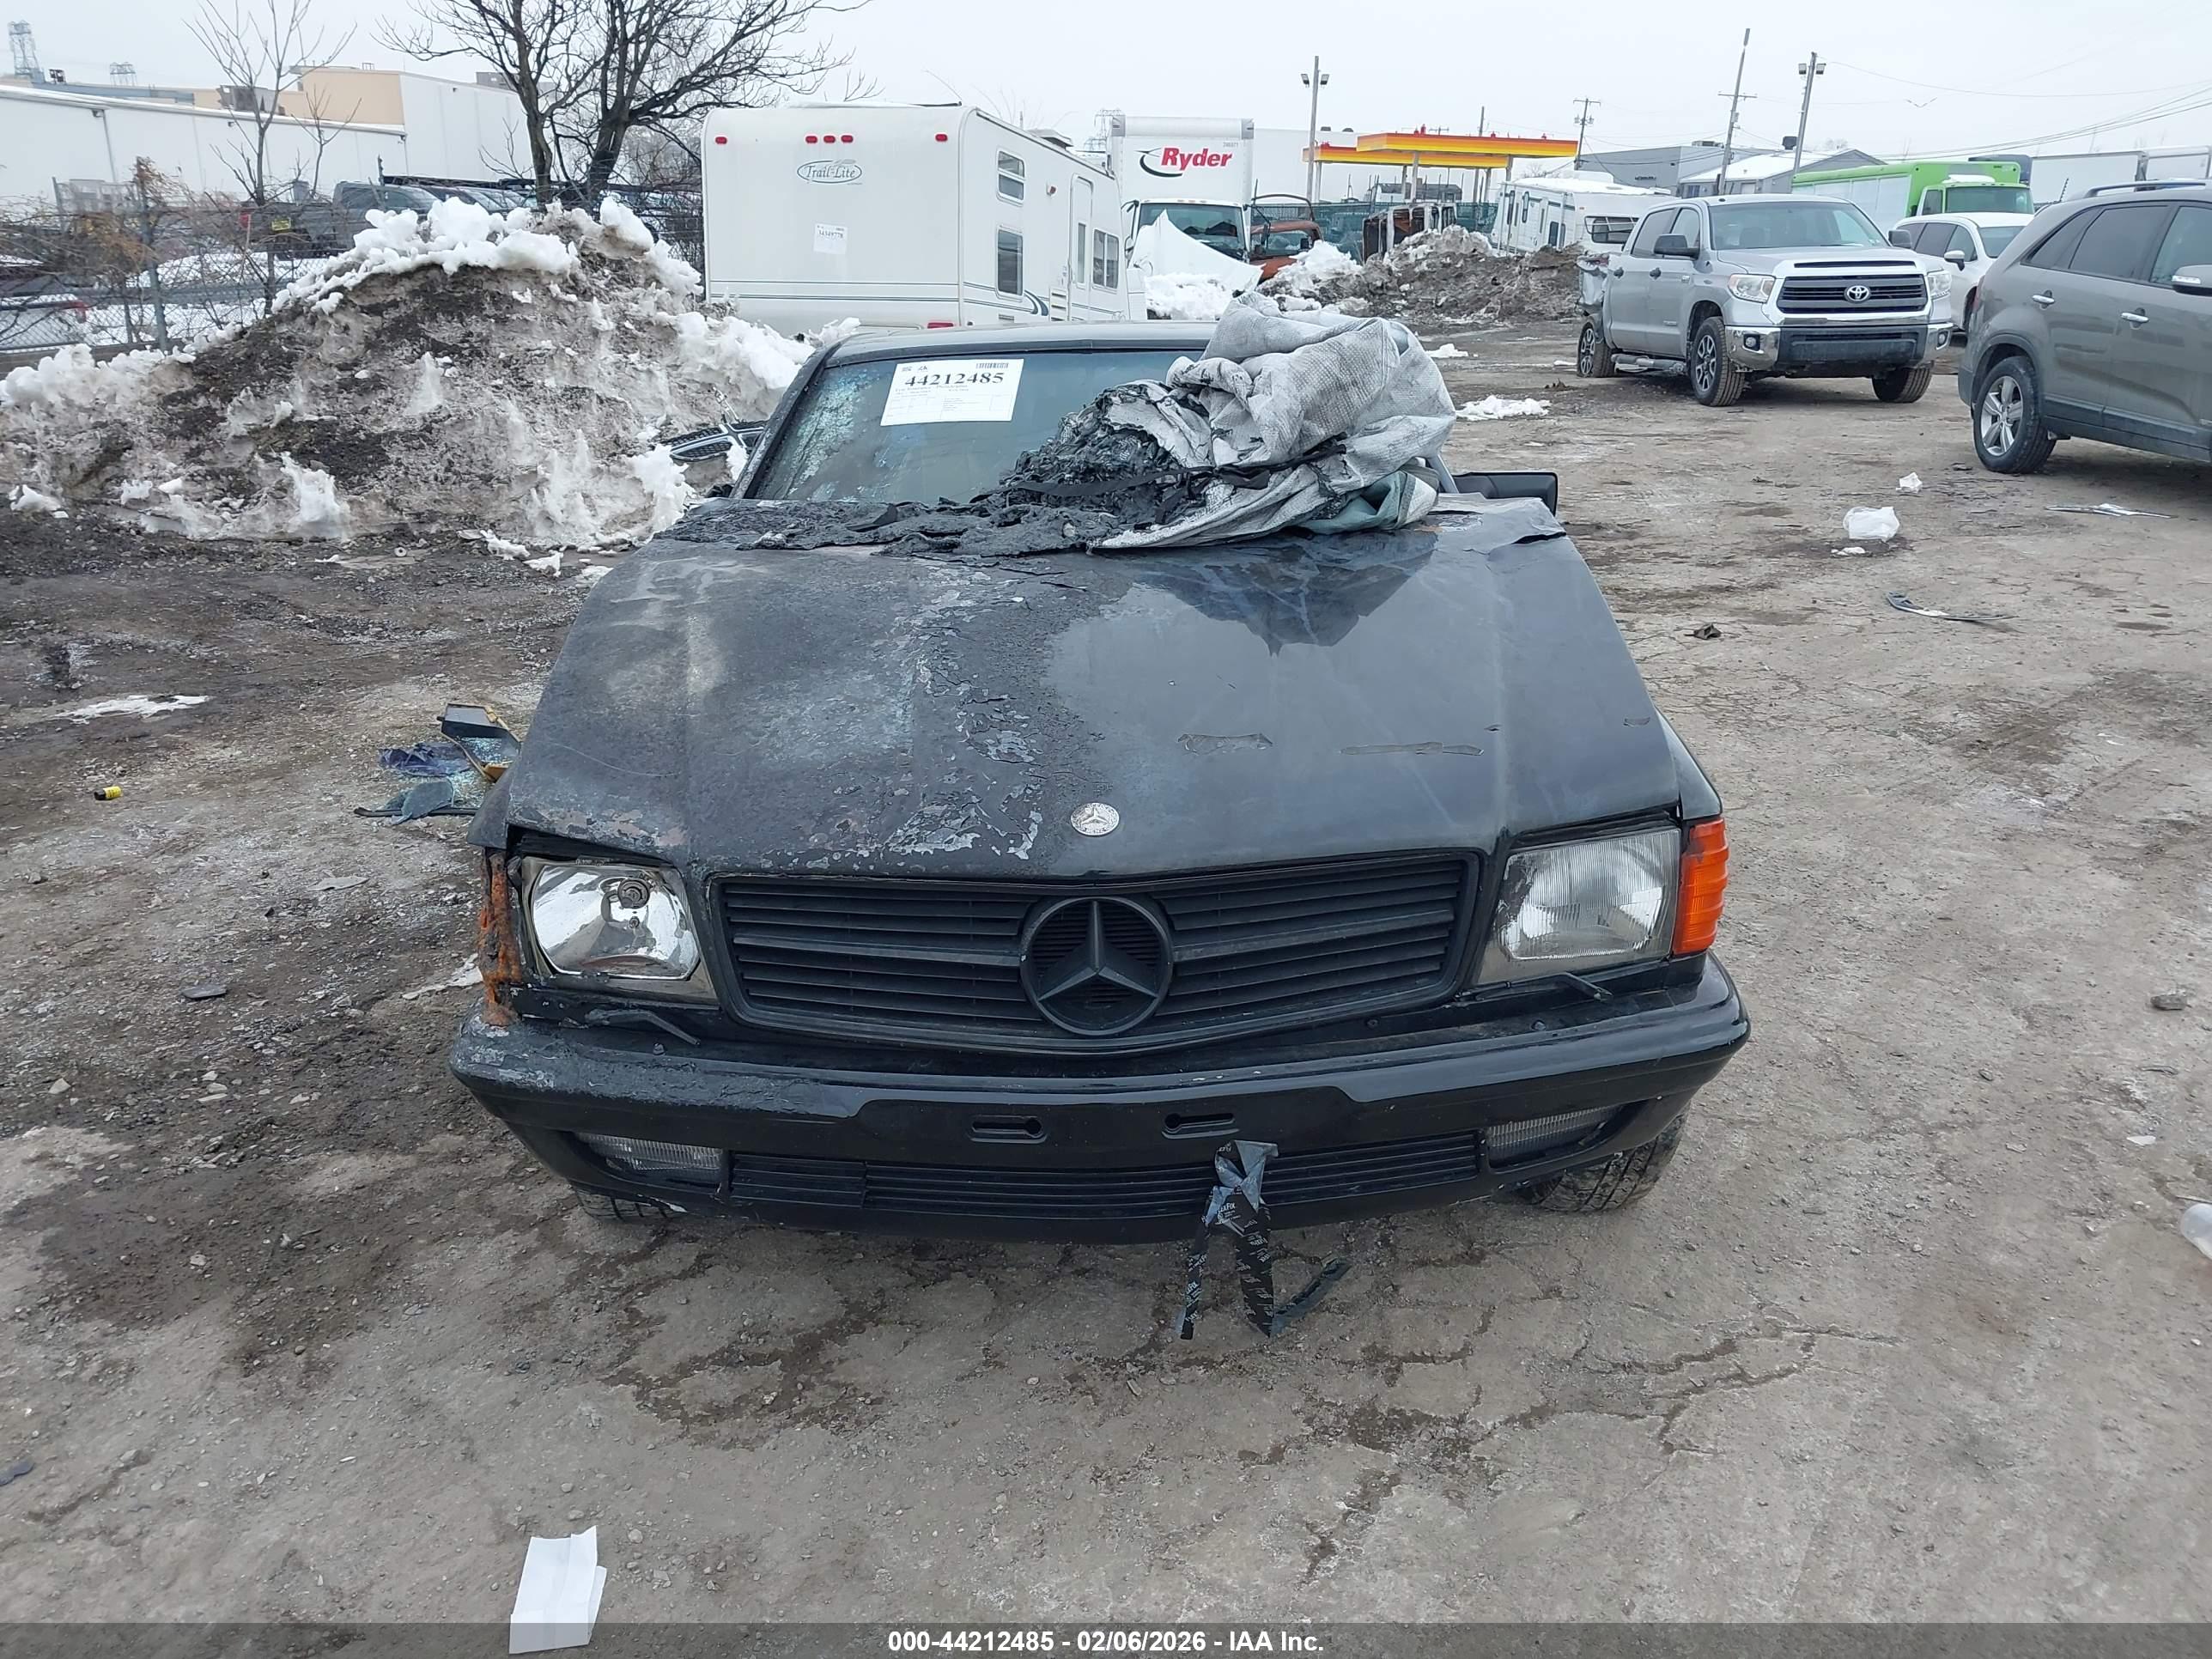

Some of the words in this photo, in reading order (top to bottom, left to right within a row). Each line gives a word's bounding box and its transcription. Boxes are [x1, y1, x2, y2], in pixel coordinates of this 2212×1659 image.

[1161, 147, 1233, 171] Ryder
[805, 165, 856, 178] Trail-Lite
[904, 372, 1005, 386] 44212485
